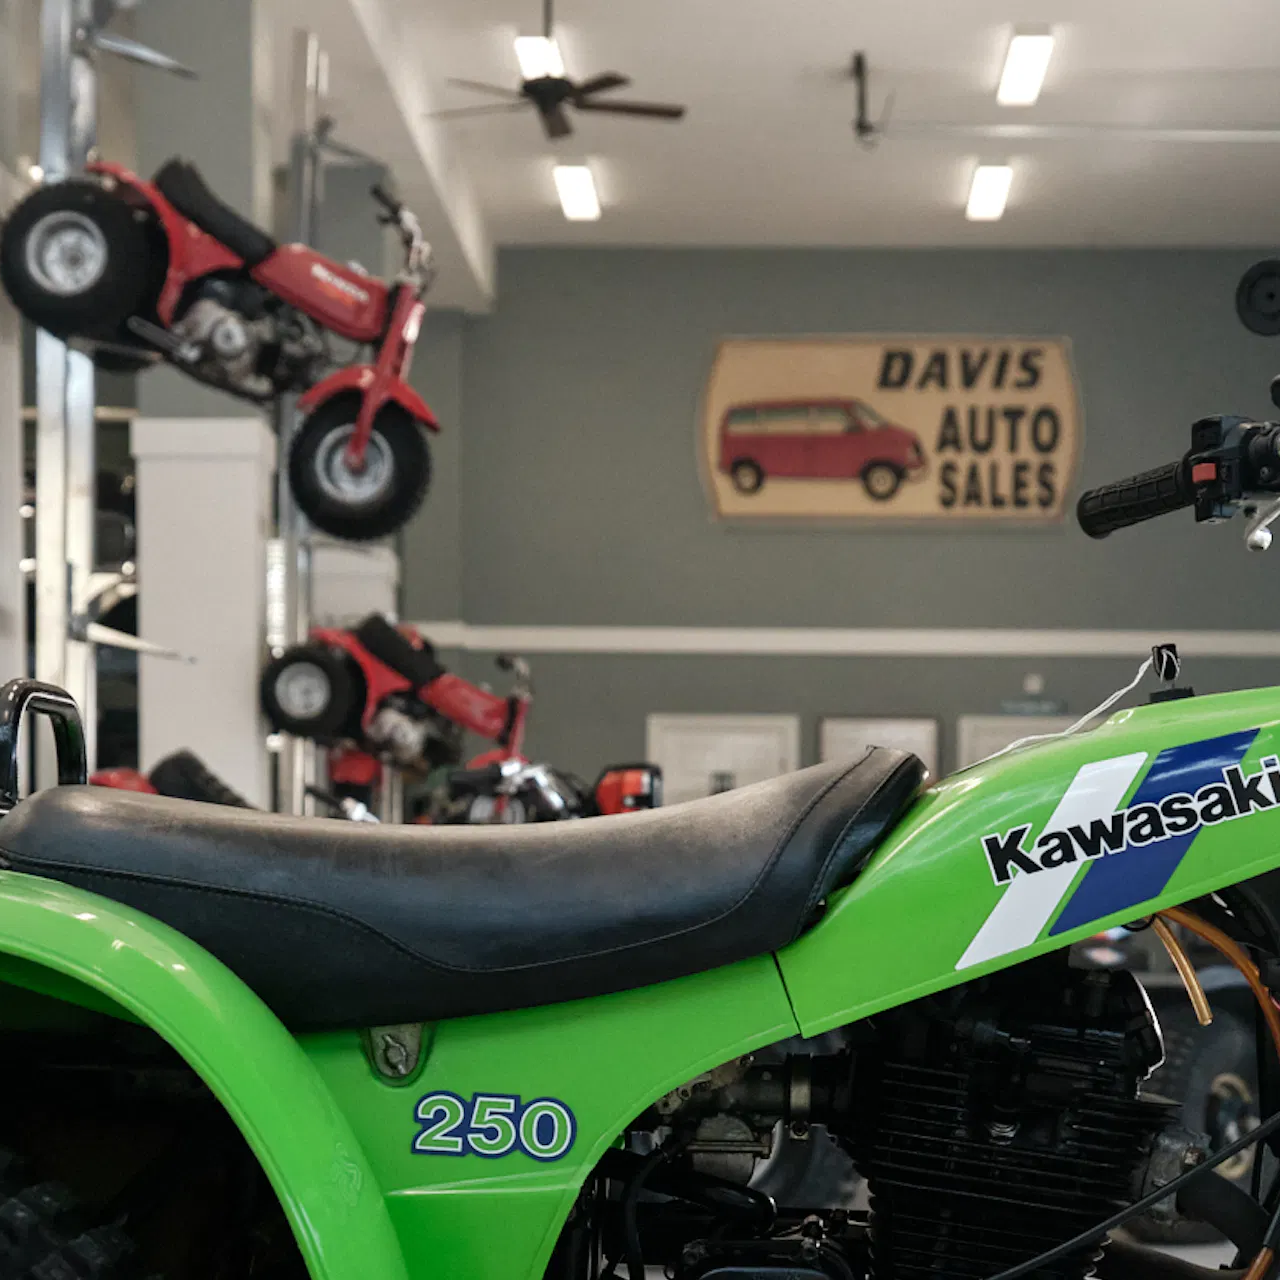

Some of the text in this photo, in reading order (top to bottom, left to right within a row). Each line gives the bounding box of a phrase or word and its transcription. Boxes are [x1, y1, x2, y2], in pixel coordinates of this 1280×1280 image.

[877, 346, 1045, 391] DAVIS
[935, 404, 1061, 454] AUTO
[939, 460, 1057, 509] SALES
[411, 1090, 577, 1163] 250
